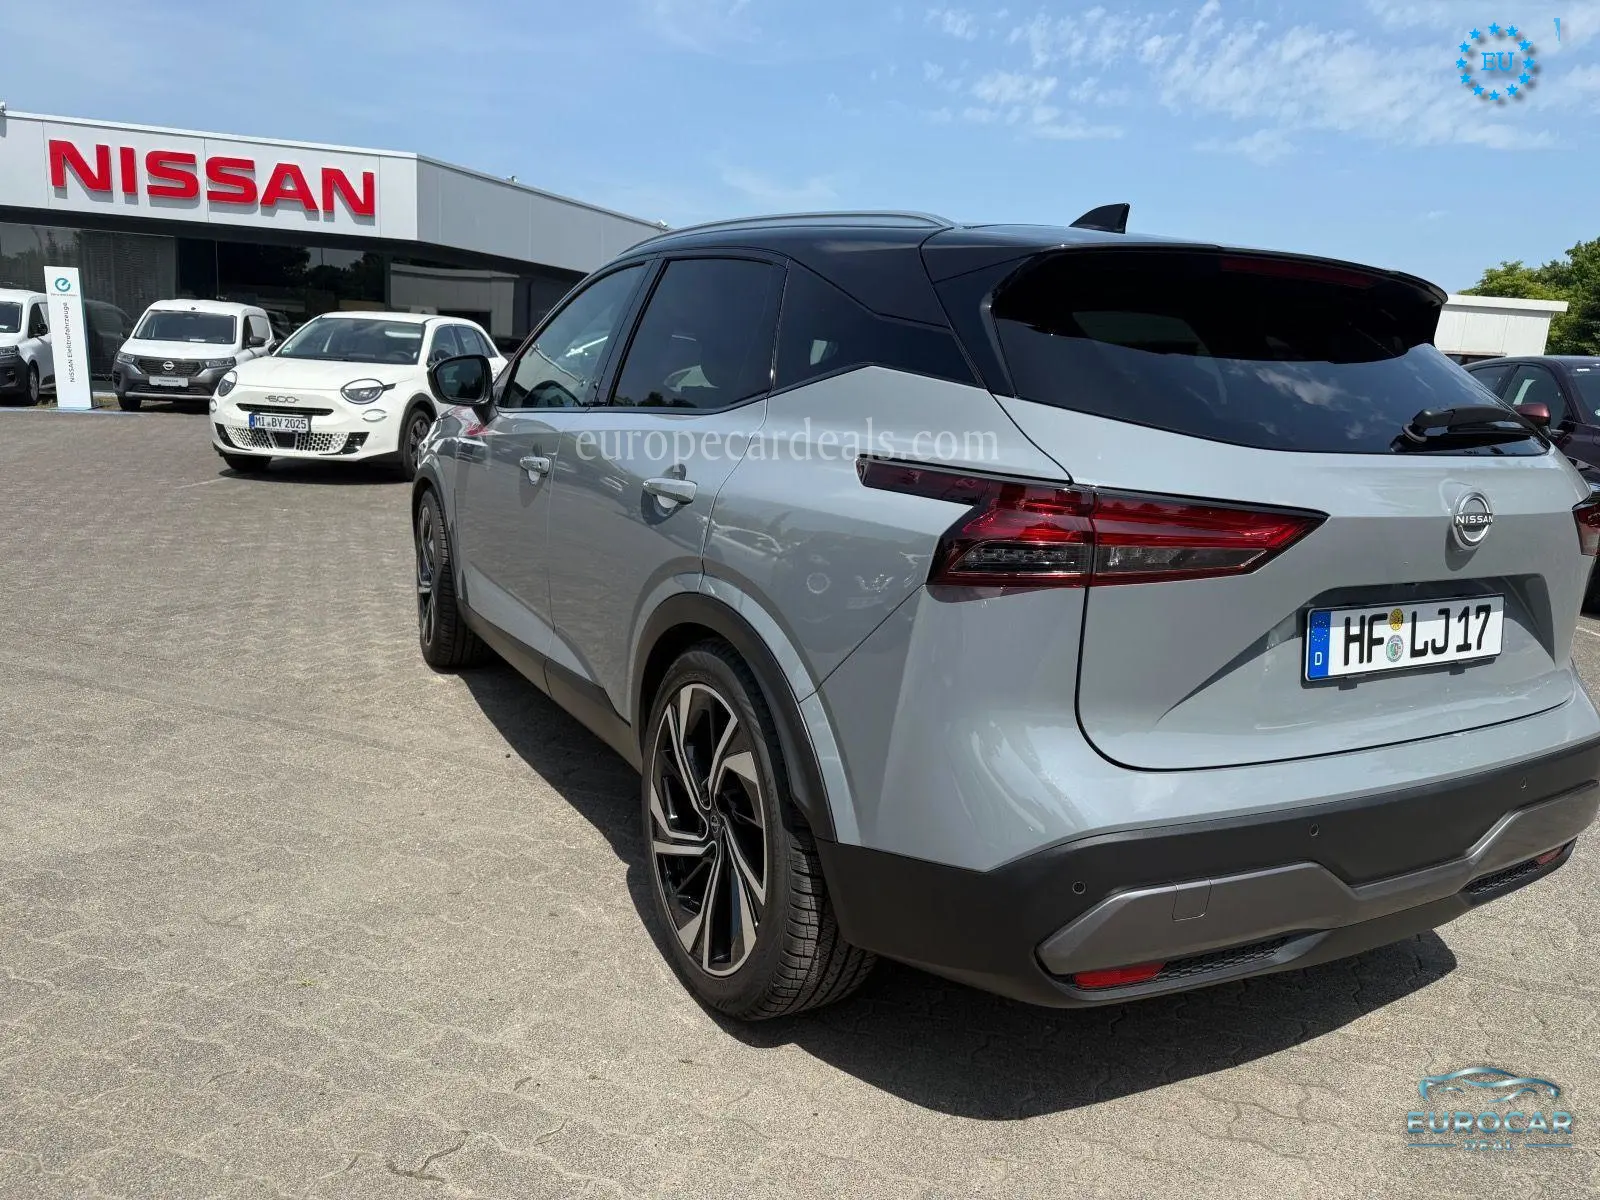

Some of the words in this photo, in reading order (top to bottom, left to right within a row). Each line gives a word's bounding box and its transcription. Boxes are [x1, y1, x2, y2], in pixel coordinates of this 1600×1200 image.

[49, 139, 375, 217] NISSAN
[255, 416, 266, 427] MI
[271, 418, 283, 428] BY
[284, 418, 307, 430] 2025
[1455, 513, 1494, 524] NISSAN
[1343, 613, 1388, 667] HF
[1410, 607, 1451, 658] LJ
[1455, 604, 1492, 653] 17
[1314, 651, 1322, 666] D
